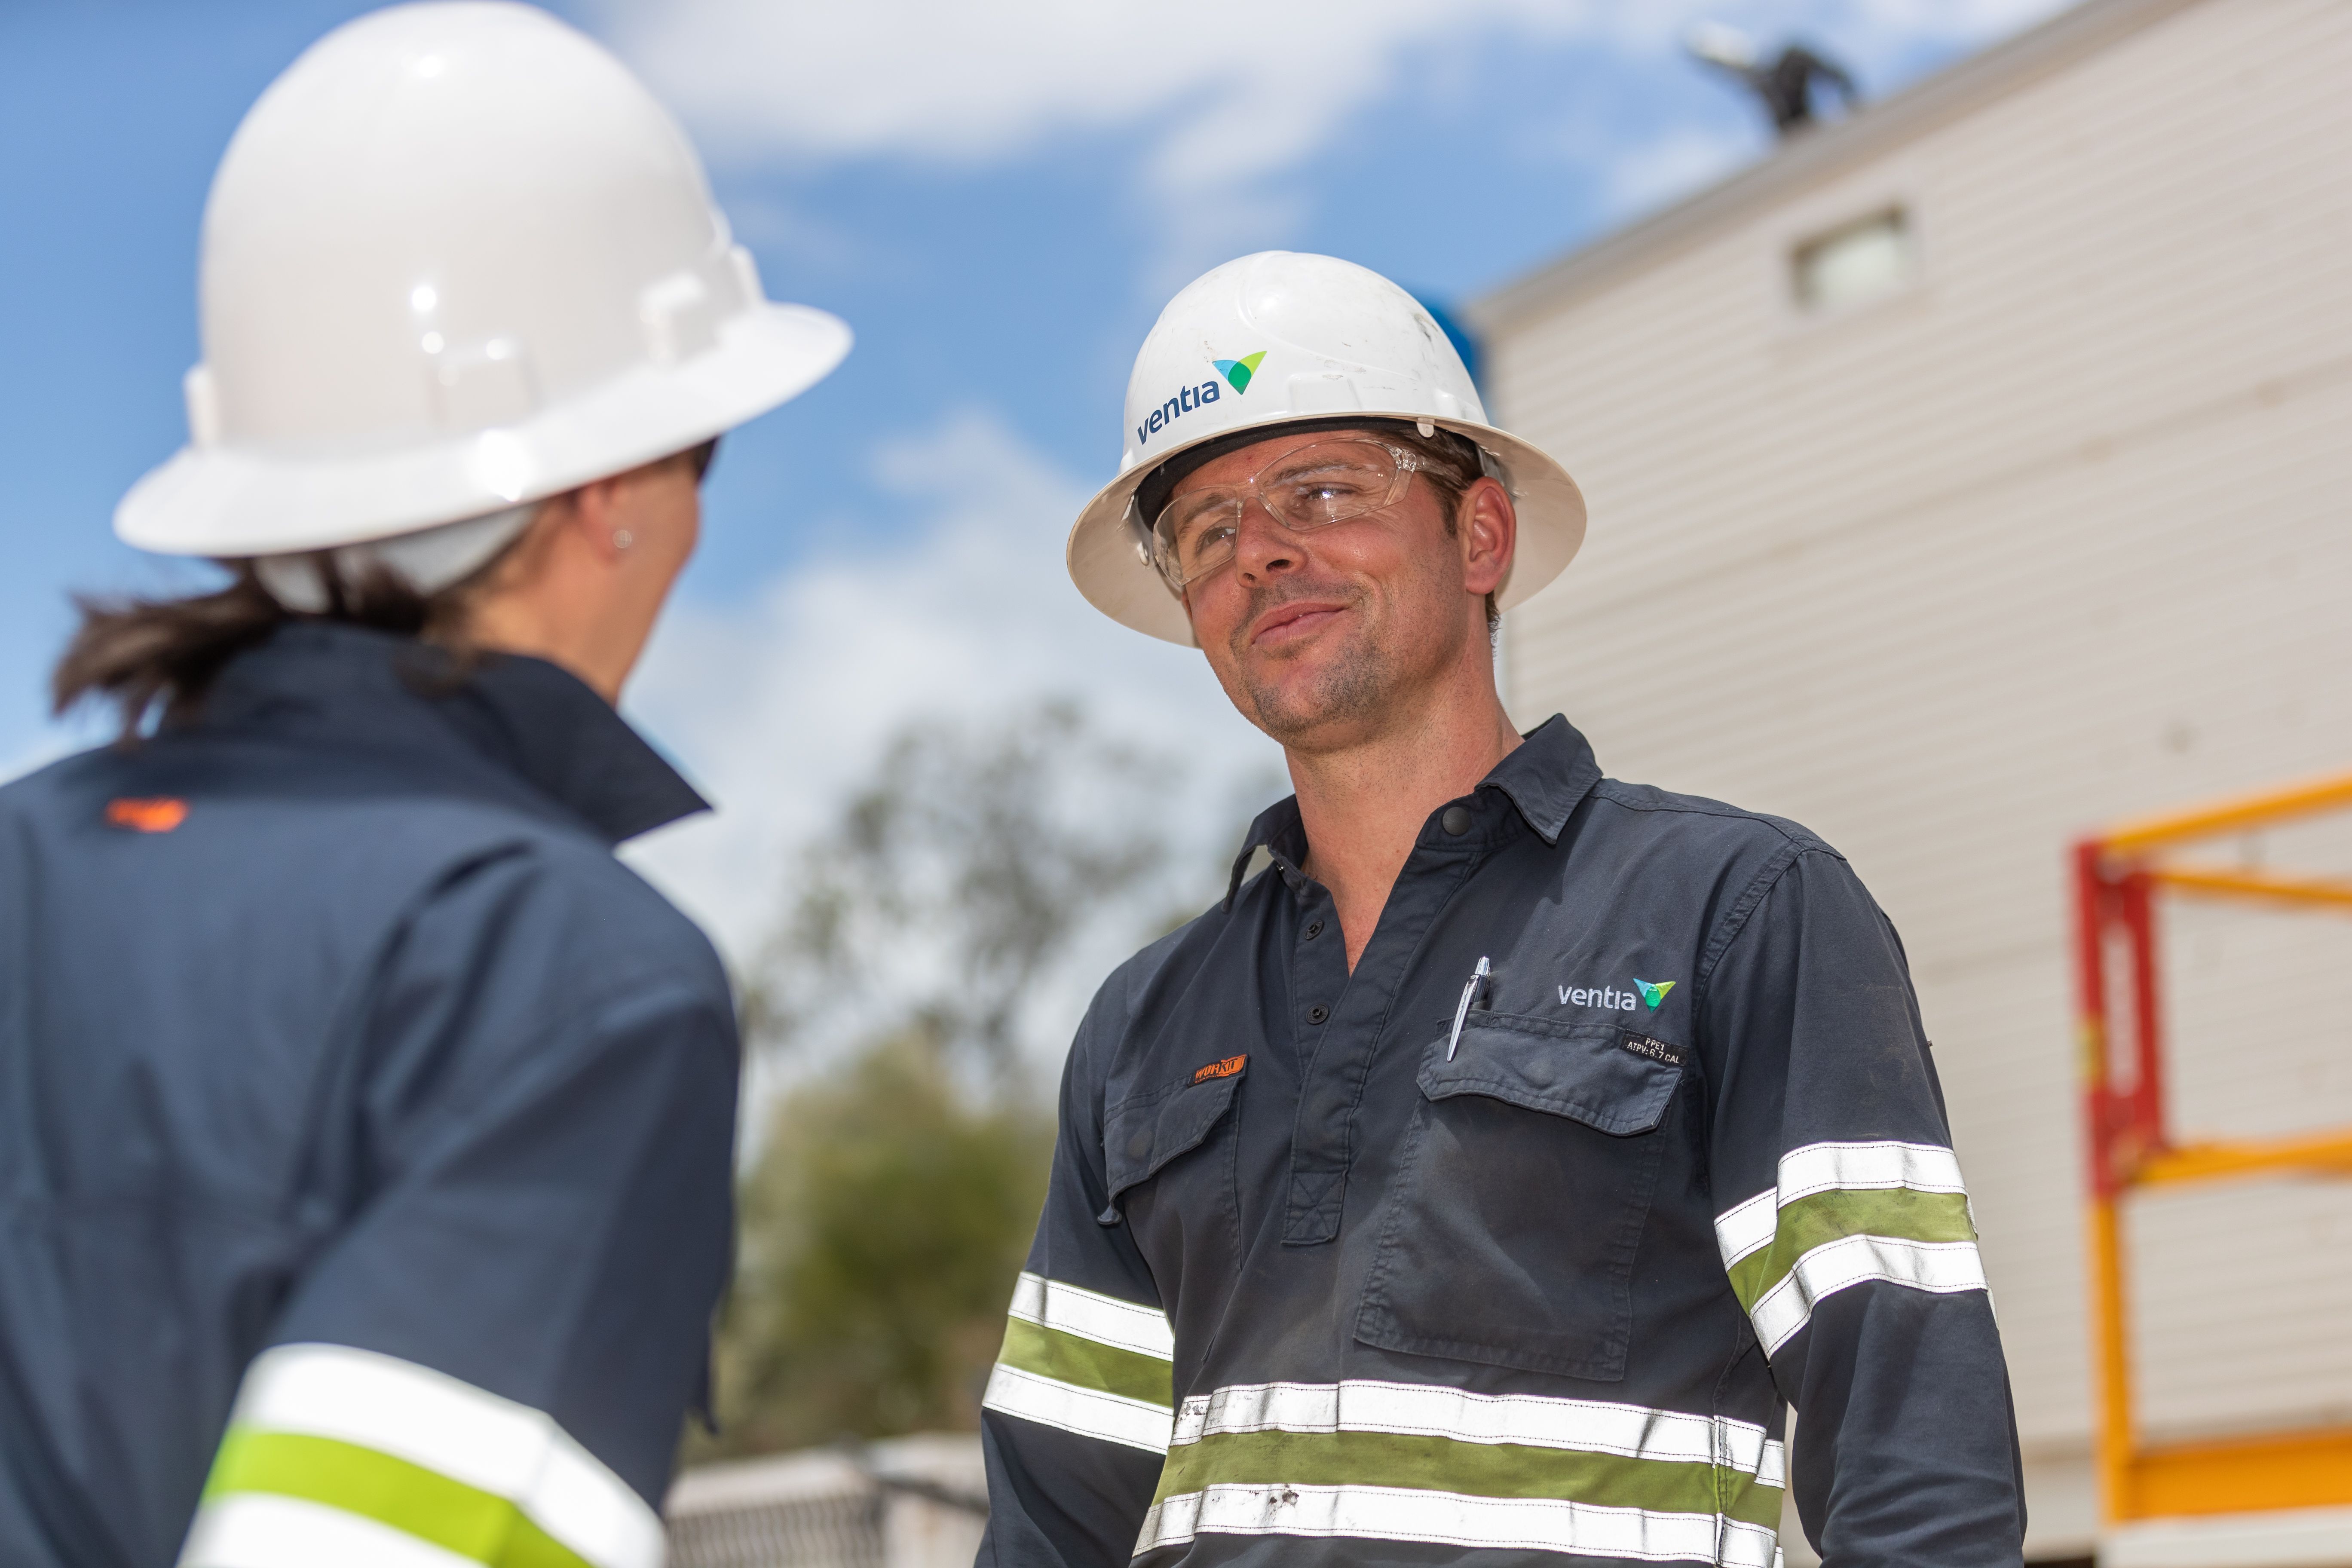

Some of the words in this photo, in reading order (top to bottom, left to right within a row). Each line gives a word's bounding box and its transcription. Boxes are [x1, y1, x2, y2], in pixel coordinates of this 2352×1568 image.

[1137, 381, 1220, 445] ventia
[1558, 985, 1637, 1011] ventia
[1645, 1038, 1665, 1050] PPE1
[1665, 1054, 1679, 1064] CAL
